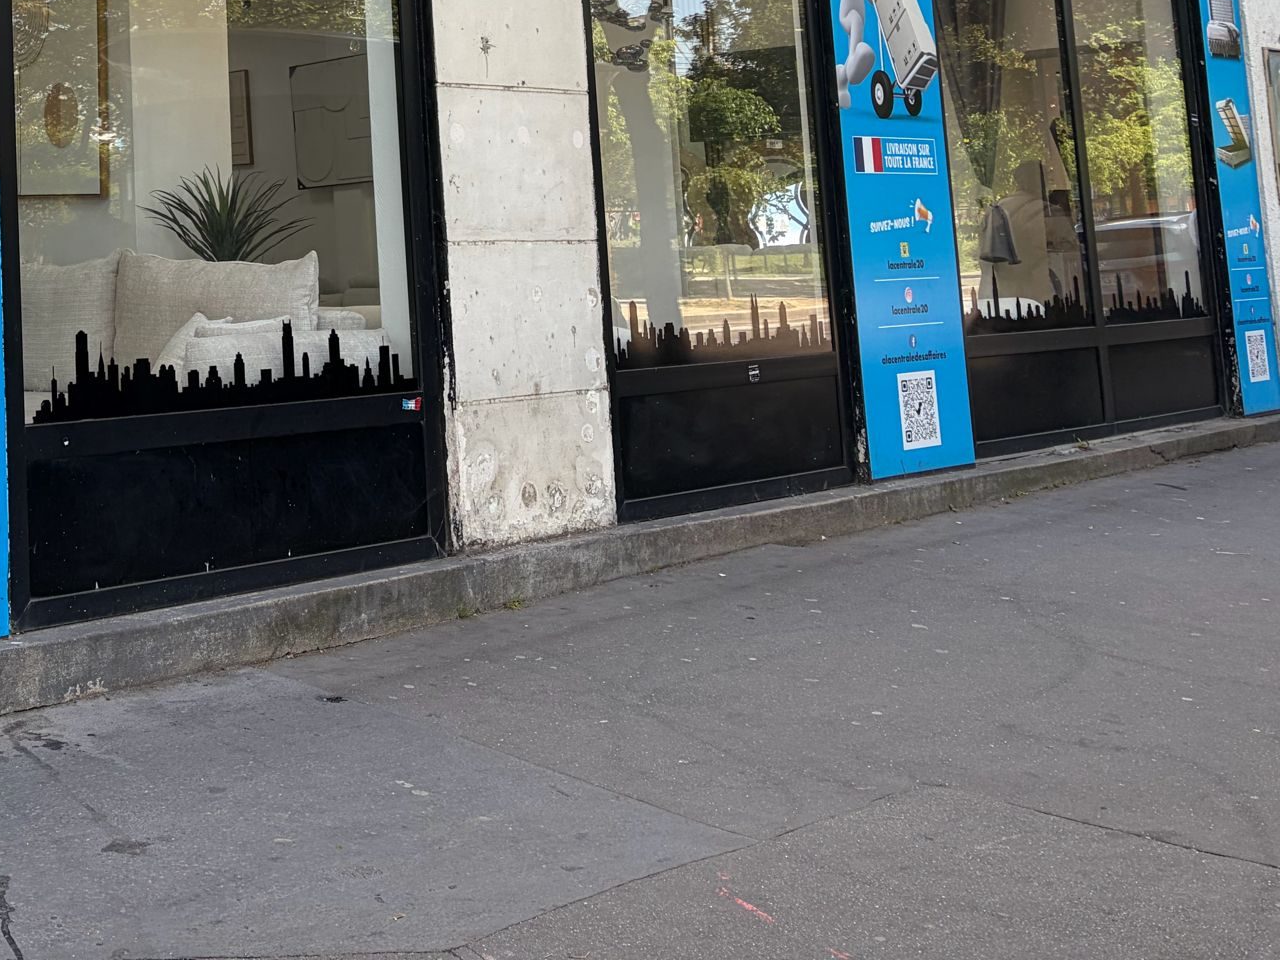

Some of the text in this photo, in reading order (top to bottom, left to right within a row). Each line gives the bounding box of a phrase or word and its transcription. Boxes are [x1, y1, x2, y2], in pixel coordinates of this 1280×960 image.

[886, 142, 930, 156] LIVRAISON SUR
[884, 156, 934, 169] TOUTE LA FRANCE
